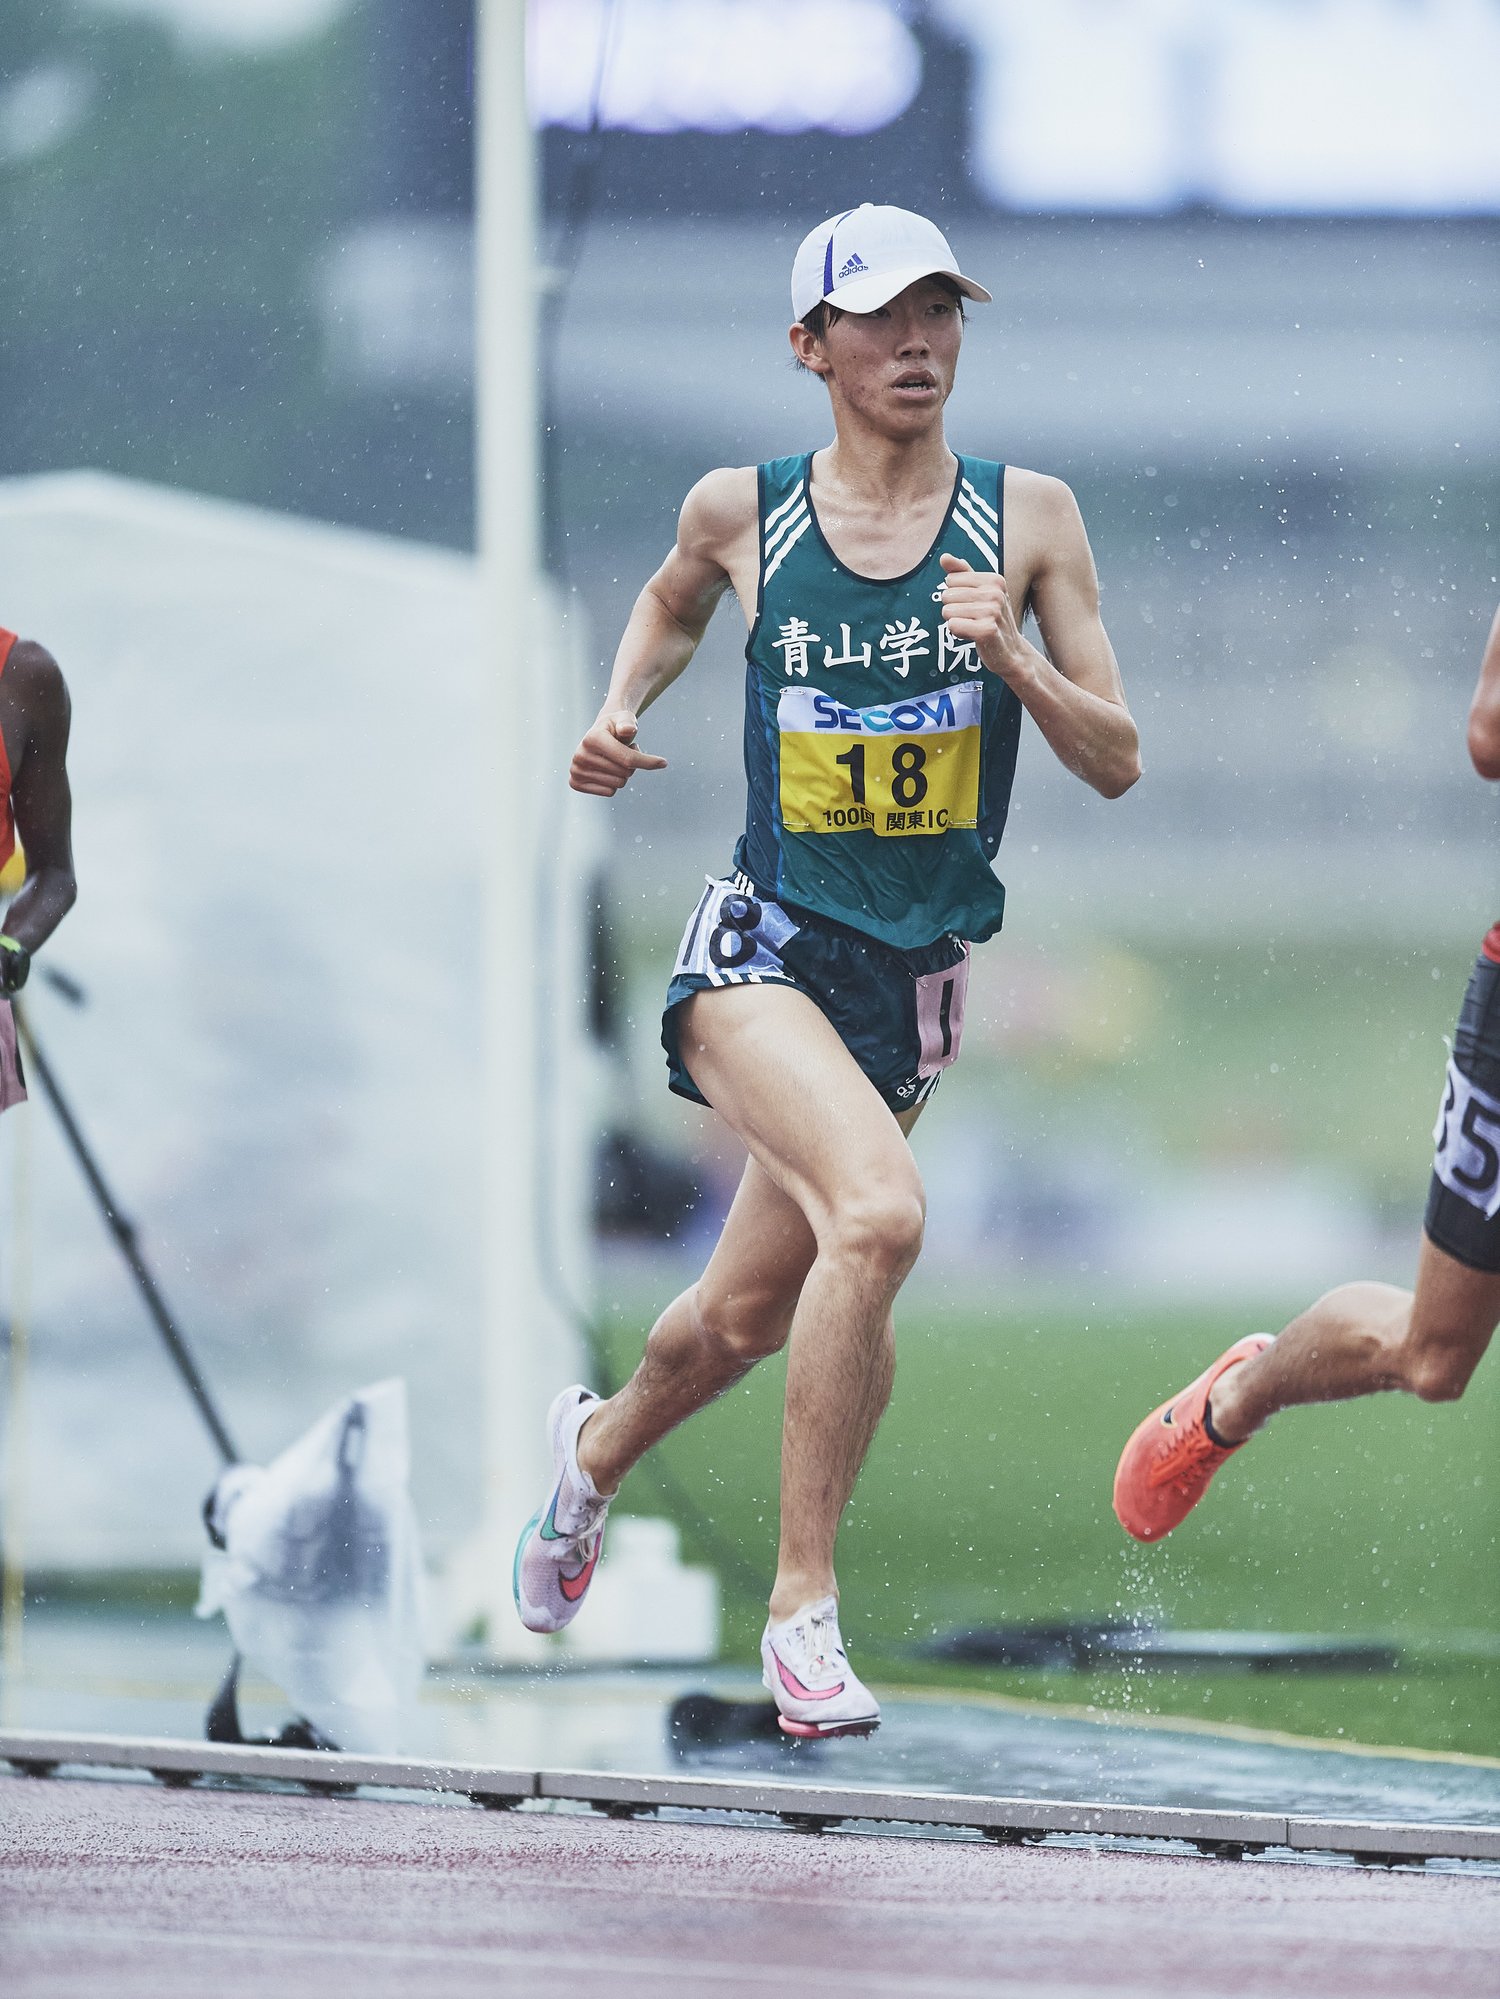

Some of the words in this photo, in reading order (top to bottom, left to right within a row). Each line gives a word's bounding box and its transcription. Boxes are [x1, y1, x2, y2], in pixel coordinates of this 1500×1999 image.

[838, 265, 869, 279] adidas
[771, 616, 983, 678] 青山学院
[813, 693, 956, 733] SECOM
[836, 742, 928, 807] 18
[886, 808, 949, 831] 関東IC
[682, 885, 762, 968] 18
